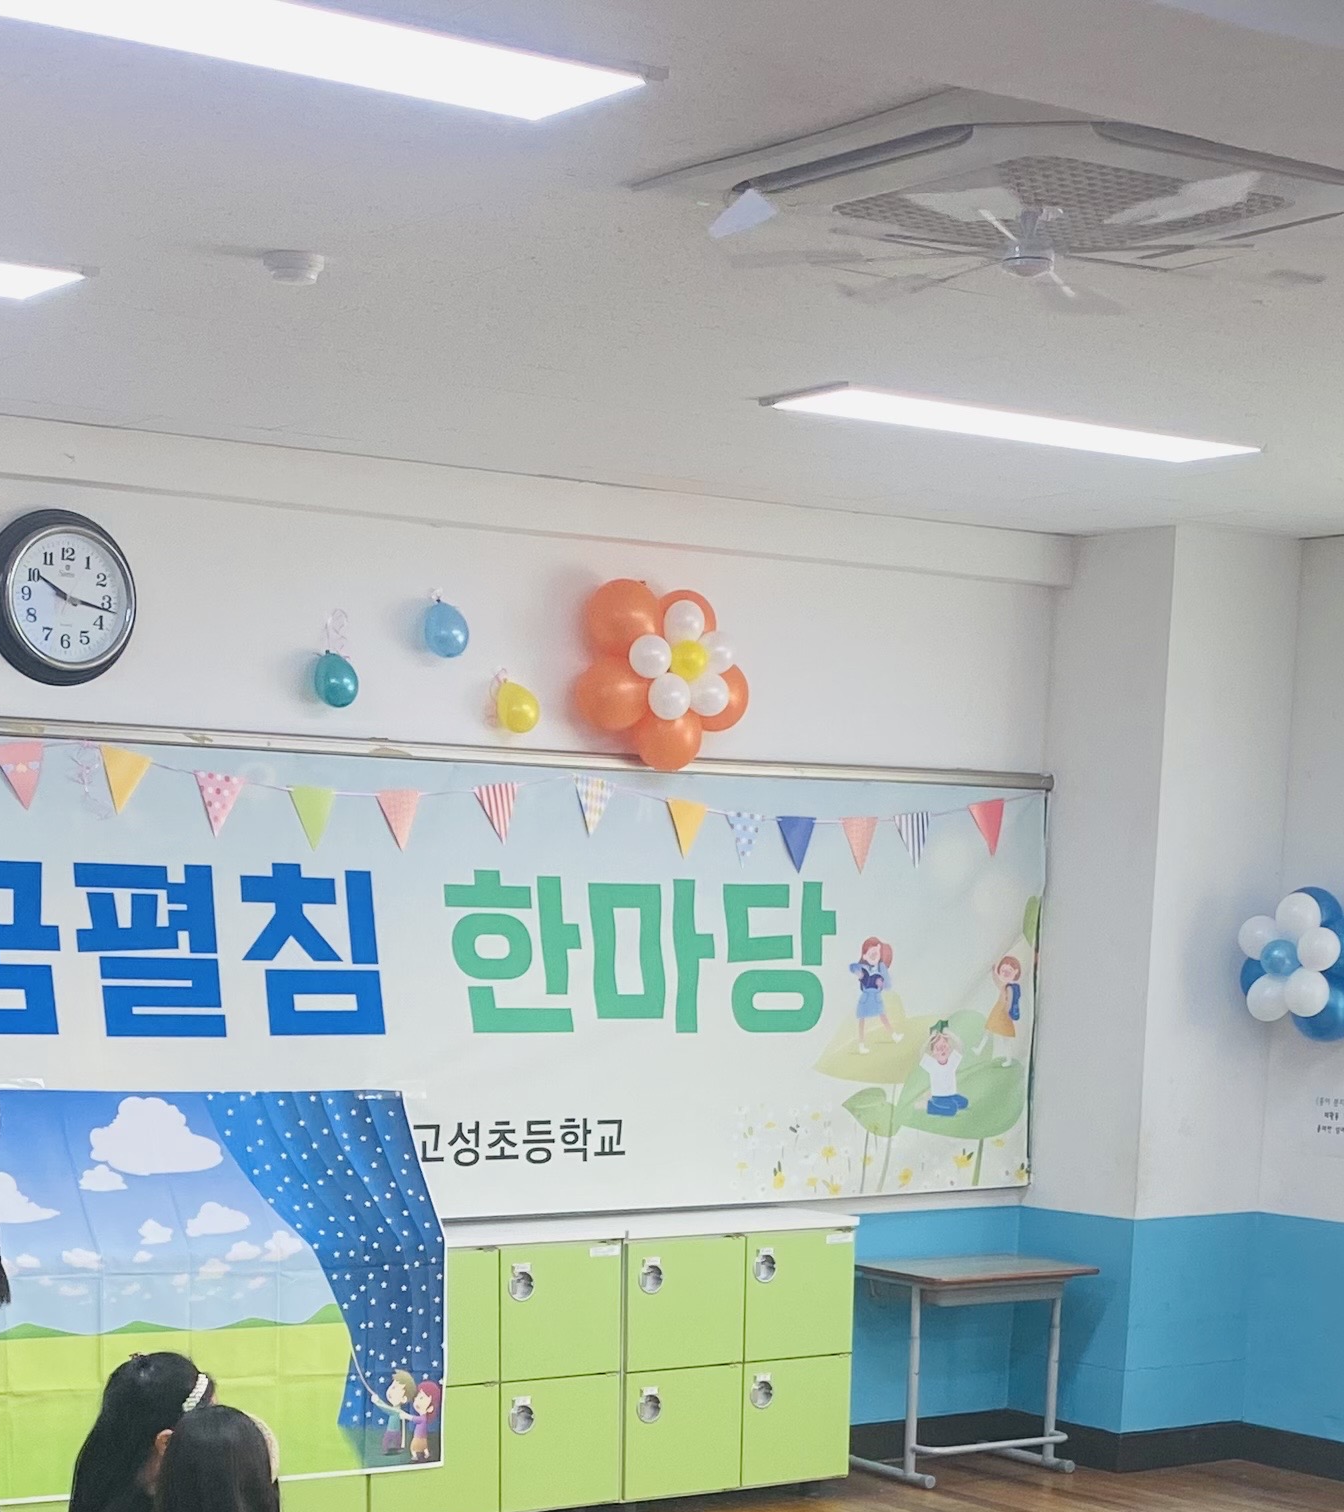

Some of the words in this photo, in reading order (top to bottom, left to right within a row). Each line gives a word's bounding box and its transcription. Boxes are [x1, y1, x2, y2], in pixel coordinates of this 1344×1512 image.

[43, 552, 54, 566] 11
[61, 547, 75, 561] 12
[85, 556, 91, 570] 1
[28, 568, 40, 582] 10
[96, 573, 107, 587] 2
[21, 586, 31, 600] 9
[101, 595, 112, 610] 3
[26, 607, 37, 623] 8
[93, 615, 104, 630] 4
[42, 627, 53, 641] 7
[80, 631, 90, 645] 5
[60, 634, 71, 649] 6
[443, 869, 837, 1034] 한마당
[413, 1117, 626, 1166] 고성초등학교
